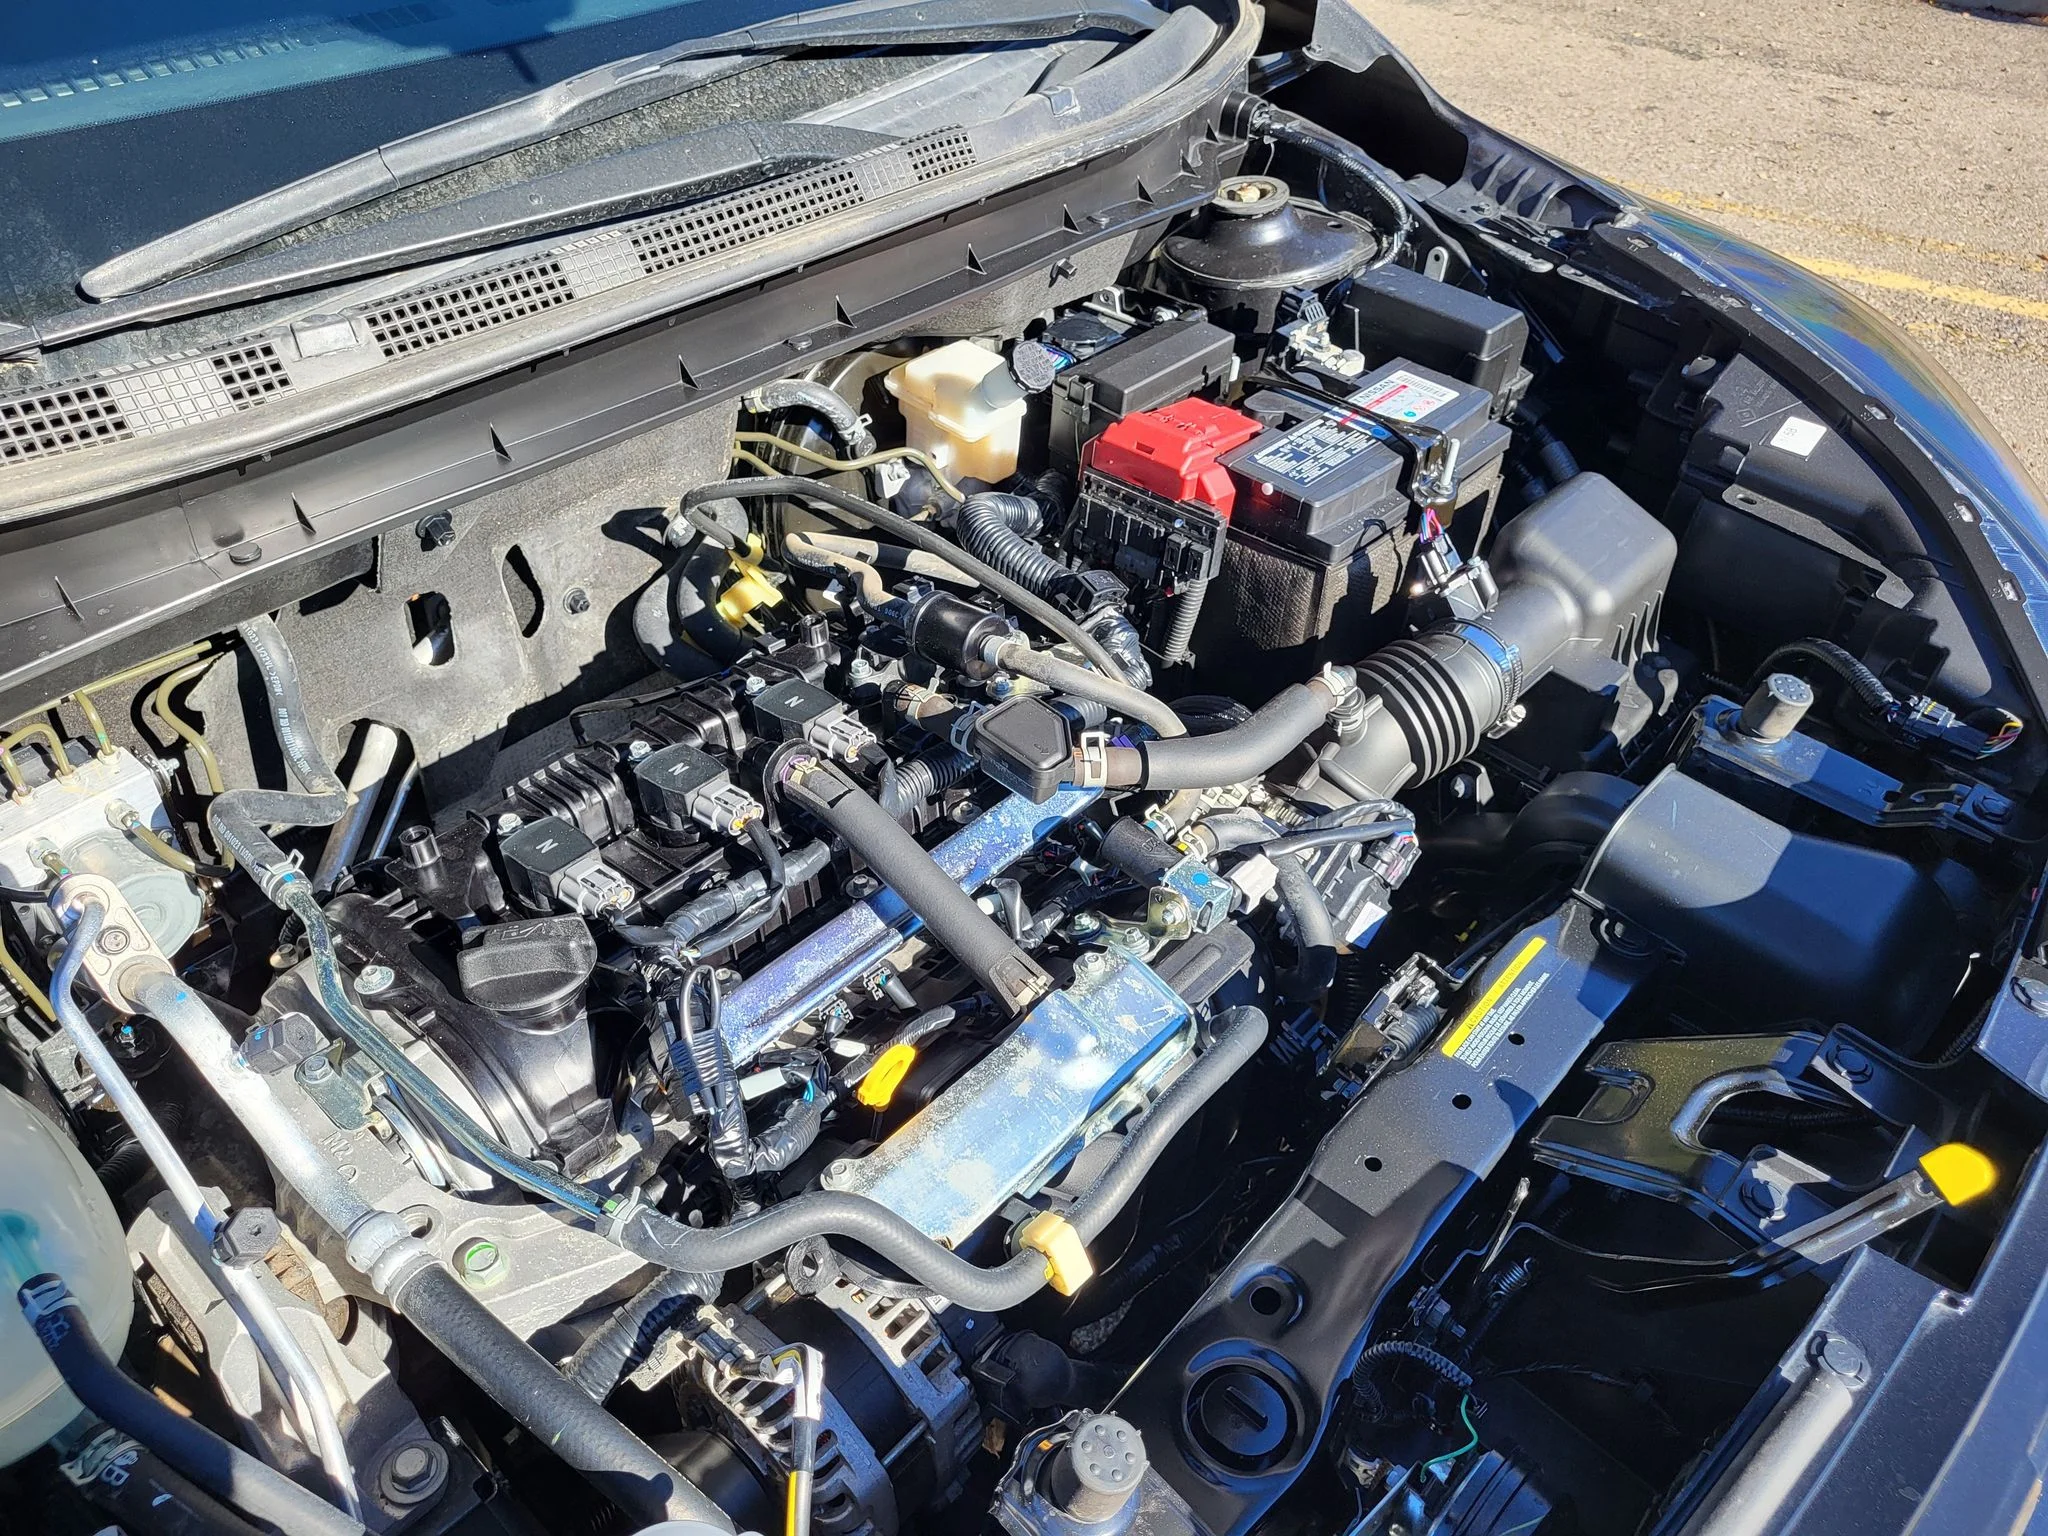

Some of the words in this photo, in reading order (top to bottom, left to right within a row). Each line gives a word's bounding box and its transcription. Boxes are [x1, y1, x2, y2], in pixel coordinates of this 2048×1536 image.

[783, 694, 804, 708] N
[668, 761, 690, 776] N
[535, 838, 559, 854] N
[1470, 998, 1493, 1024] CAUTION
[1498, 961, 1525, 990] ATTENTION
